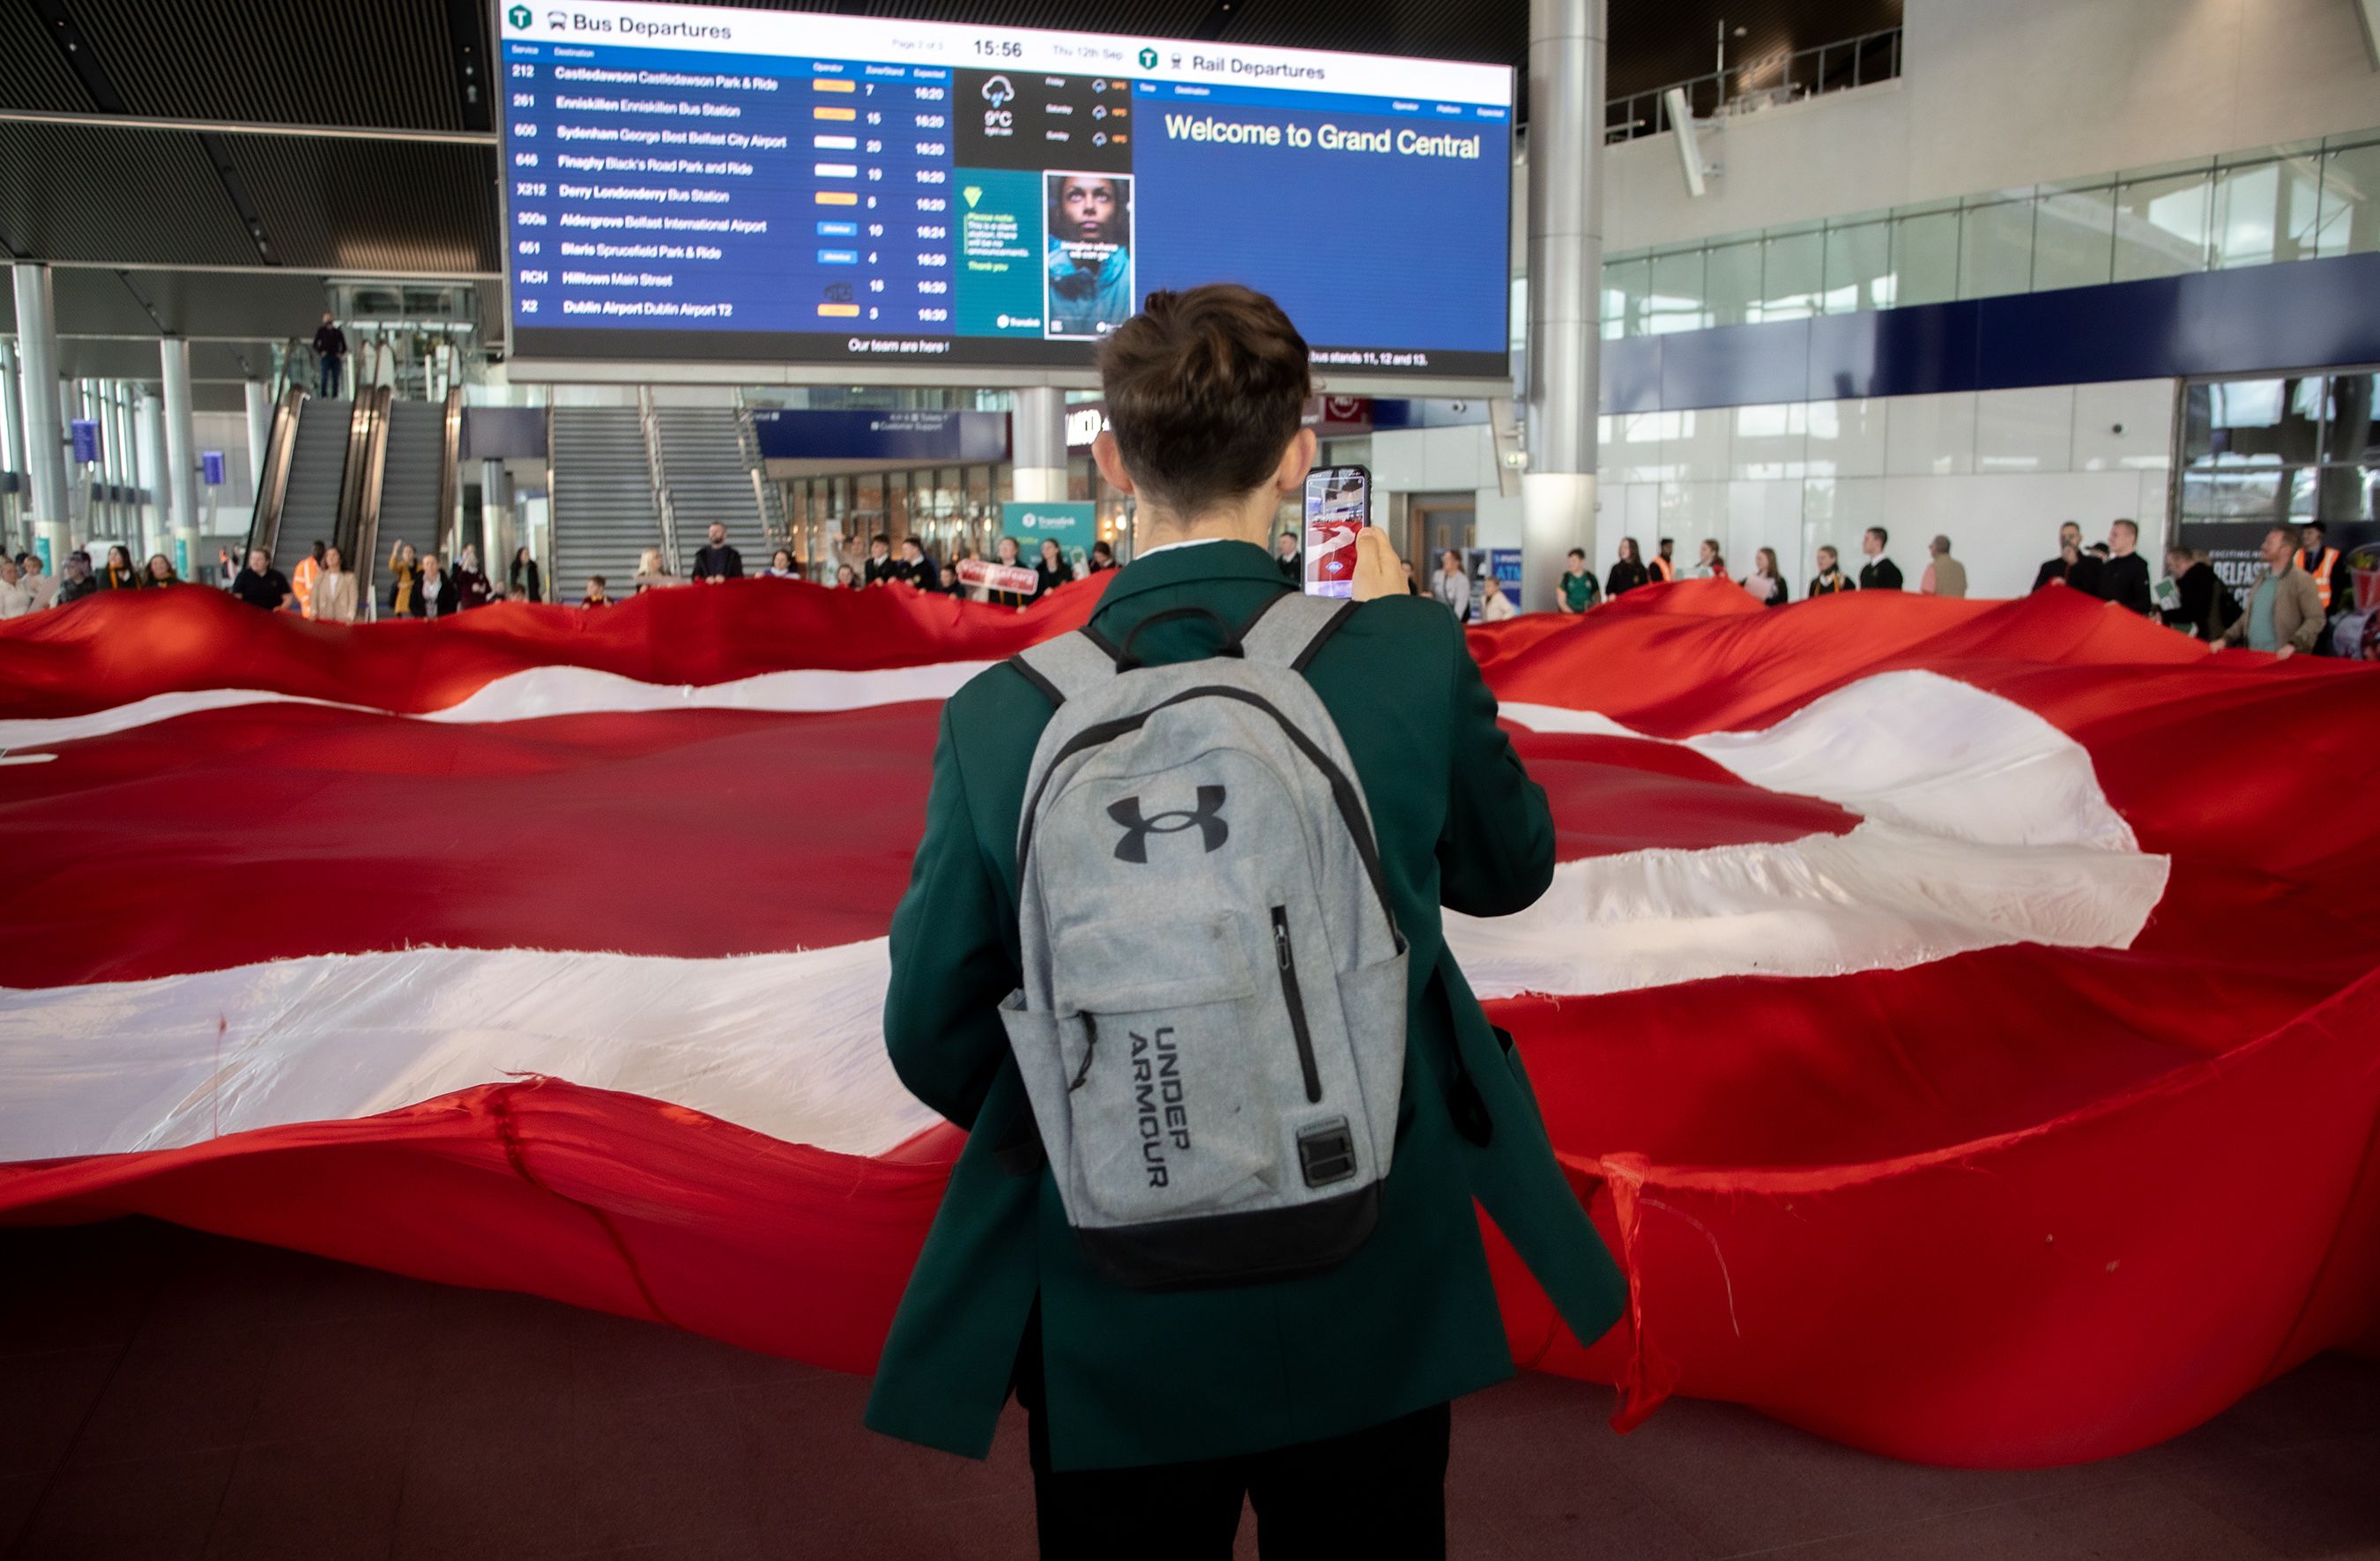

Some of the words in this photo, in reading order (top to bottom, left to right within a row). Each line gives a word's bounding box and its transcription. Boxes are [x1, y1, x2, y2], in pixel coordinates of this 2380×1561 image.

[574, 14, 612, 32] Bus
[620, 18, 732, 39] Departures
[974, 40, 1023, 57] 15:56
[1053, 45, 1073, 56] Thu
[1078, 47, 1098, 57] 12th
[1104, 49, 1124, 61] Sep
[512, 64, 535, 78] 212
[554, 66, 637, 84] Castledawson
[638, 71, 714, 88] Castledawson
[715, 76, 740, 89] Park
[741, 78, 752, 90] &
[753, 78, 778, 92] Ride
[1193, 56, 1224, 73] Rail
[1231, 59, 1325, 80] Departures
[865, 84, 874, 96] 7
[555, 95, 620, 112] Enniskillen
[620, 99, 678, 115] Enniskillen
[679, 102, 701, 116] Bus
[702, 103, 741, 118] Station
[556, 125, 619, 143] Sydenham
[620, 128, 661, 145] George
[662, 130, 688, 145] Best
[688, 131, 726, 146] Belfast
[727, 133, 750, 149] City
[750, 134, 788, 150] Airport
[1164, 114, 1281, 145] Welcome
[1286, 123, 1312, 147] to
[1317, 123, 1391, 153] Grand
[1396, 130, 1480, 159] Central
[557, 154, 606, 172] Finaghy
[606, 157, 646, 172] Black's
[647, 159, 677, 173] Road
[678, 160, 703, 175] Park
[705, 161, 725, 175] and
[727, 162, 754, 176] Ride
[517, 182, 547, 197] X212
[559, 183, 592, 201] Derry
[593, 185, 668, 204] Londonderry
[667, 189, 690, 203] Bus
[690, 190, 730, 204] Station
[560, 213, 624, 230] Aldergrove
[624, 215, 663, 230] Belfast
[664, 217, 729, 232] International
[730, 219, 768, 234] Airport
[596, 243, 658, 259] Sprucefield
[658, 246, 685, 259] Park
[686, 247, 695, 259] &
[696, 246, 722, 260] Ride
[868, 251, 878, 264] 4
[520, 271, 548, 285] RCH
[562, 271, 610, 286] Hilltown
[611, 273, 638, 286] Main
[640, 273, 673, 288] Street
[521, 300, 539, 314] X2
[563, 301, 602, 316] Dublin
[602, 301, 643, 317] Airport
[644, 302, 679, 316] Dublin
[680, 303, 717, 318] Airport
[718, 304, 733, 317] T2
[848, 338, 870, 353] Our
[870, 338, 899, 353] team
[900, 341, 919, 353] are
[919, 338, 944, 353] here
[1310, 350, 1329, 363] bus
[1329, 352, 1363, 365] stands
[1363, 352, 1379, 366] 11,
[1379, 352, 1394, 366] 12
[1393, 353, 1412, 367] and
[1155, 1027, 1190, 1152] UNDER
[1128, 1030, 1169, 1188] ARMOUR
